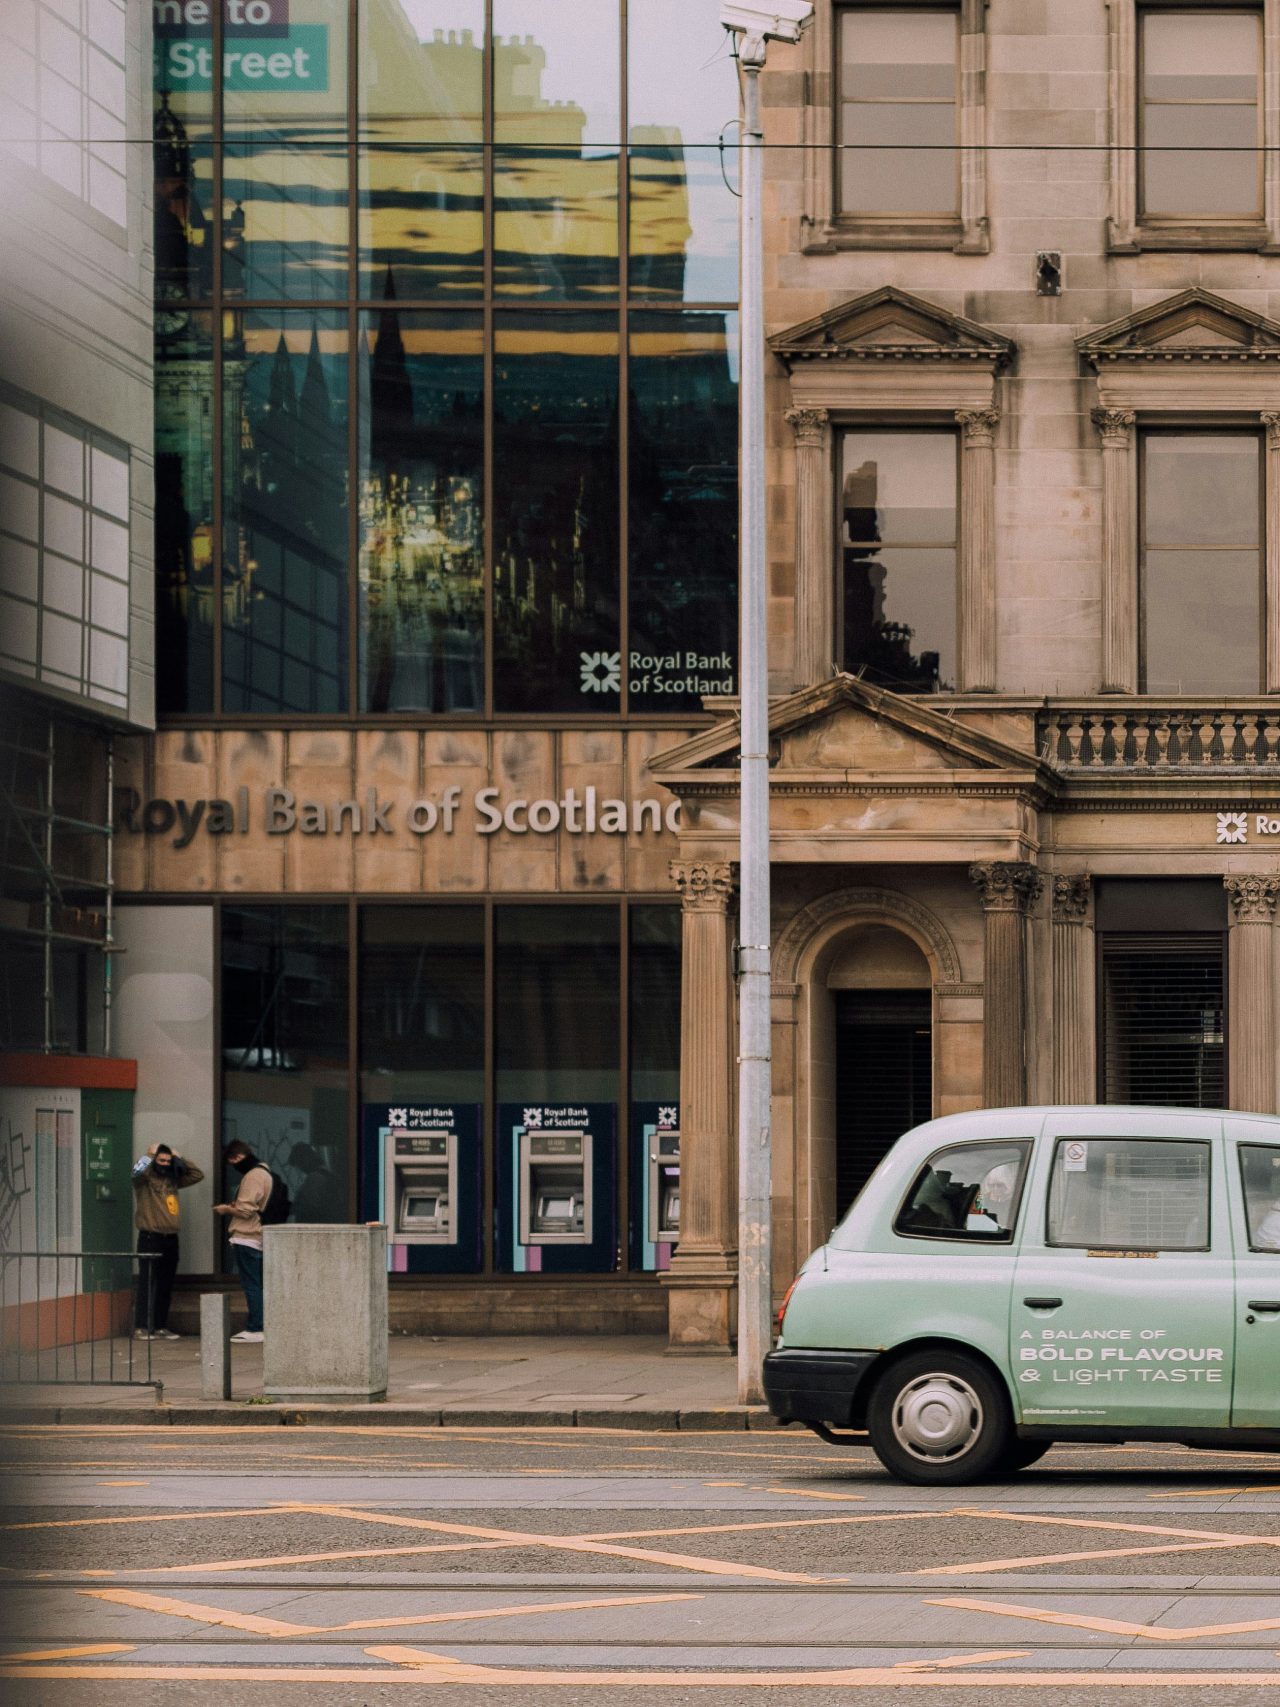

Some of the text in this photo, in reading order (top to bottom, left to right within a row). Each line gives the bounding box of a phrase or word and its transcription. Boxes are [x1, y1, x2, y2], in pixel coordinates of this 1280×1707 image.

[229, 0, 271, 25] to
[168, 42, 311, 78] Street
[630, 652, 732, 674] Royal Bank
[630, 676, 733, 693] of Scotland
[112, 785, 249, 849] Royal
[266, 786, 393, 834] Bank
[408, 785, 461, 834] of
[410, 1108, 453, 1118] Royal Bank
[544, 1107, 588, 1118] Royal Bank
[409, 1118, 455, 1127] of Scotland
[544, 1118, 589, 1127] of Scotland
[1020, 1330, 1167, 1339] A BALANCE OF
[1101, 1348, 1223, 1361] FLAVOUR
[1020, 1368, 1223, 1384] & LIGHT TASTE
